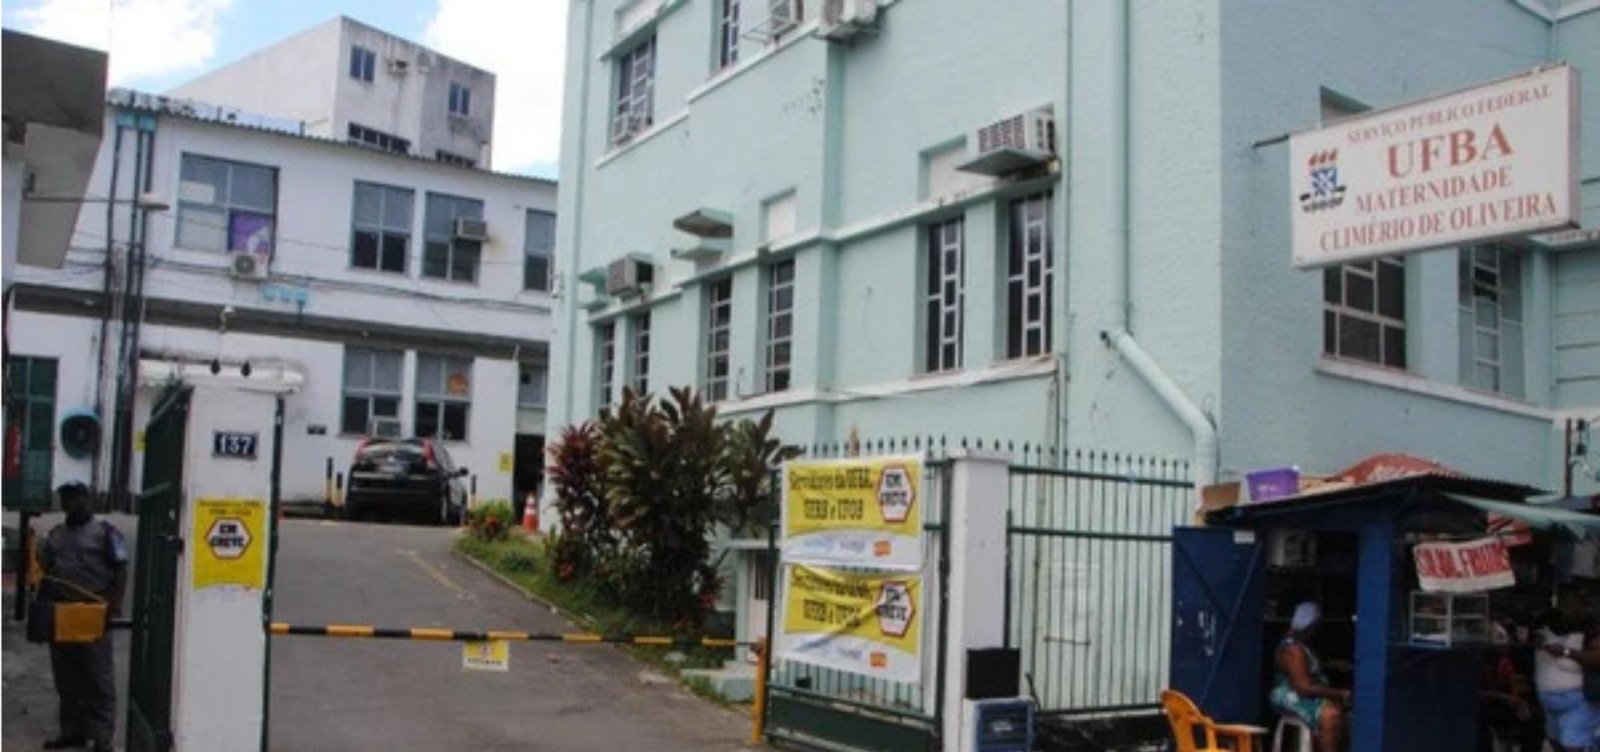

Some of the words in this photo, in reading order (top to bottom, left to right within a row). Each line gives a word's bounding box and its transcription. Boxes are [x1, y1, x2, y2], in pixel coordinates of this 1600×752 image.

[1347, 121, 1407, 144] SERVIÇO
[1478, 84, 1553, 114] FEDERAL
[1387, 123, 1515, 179] UFBA
[1355, 165, 1512, 213] MATERNIDADE
[1320, 213, 1414, 252] CLIMÉRIO
[1419, 211, 1445, 235] DE
[1450, 191, 1557, 228] OLIVEIRA
[219, 434, 252, 454] 137
[885, 473, 902, 488] EM
[210, 536, 245, 547] GREVE
[219, 525, 238, 534] EM
